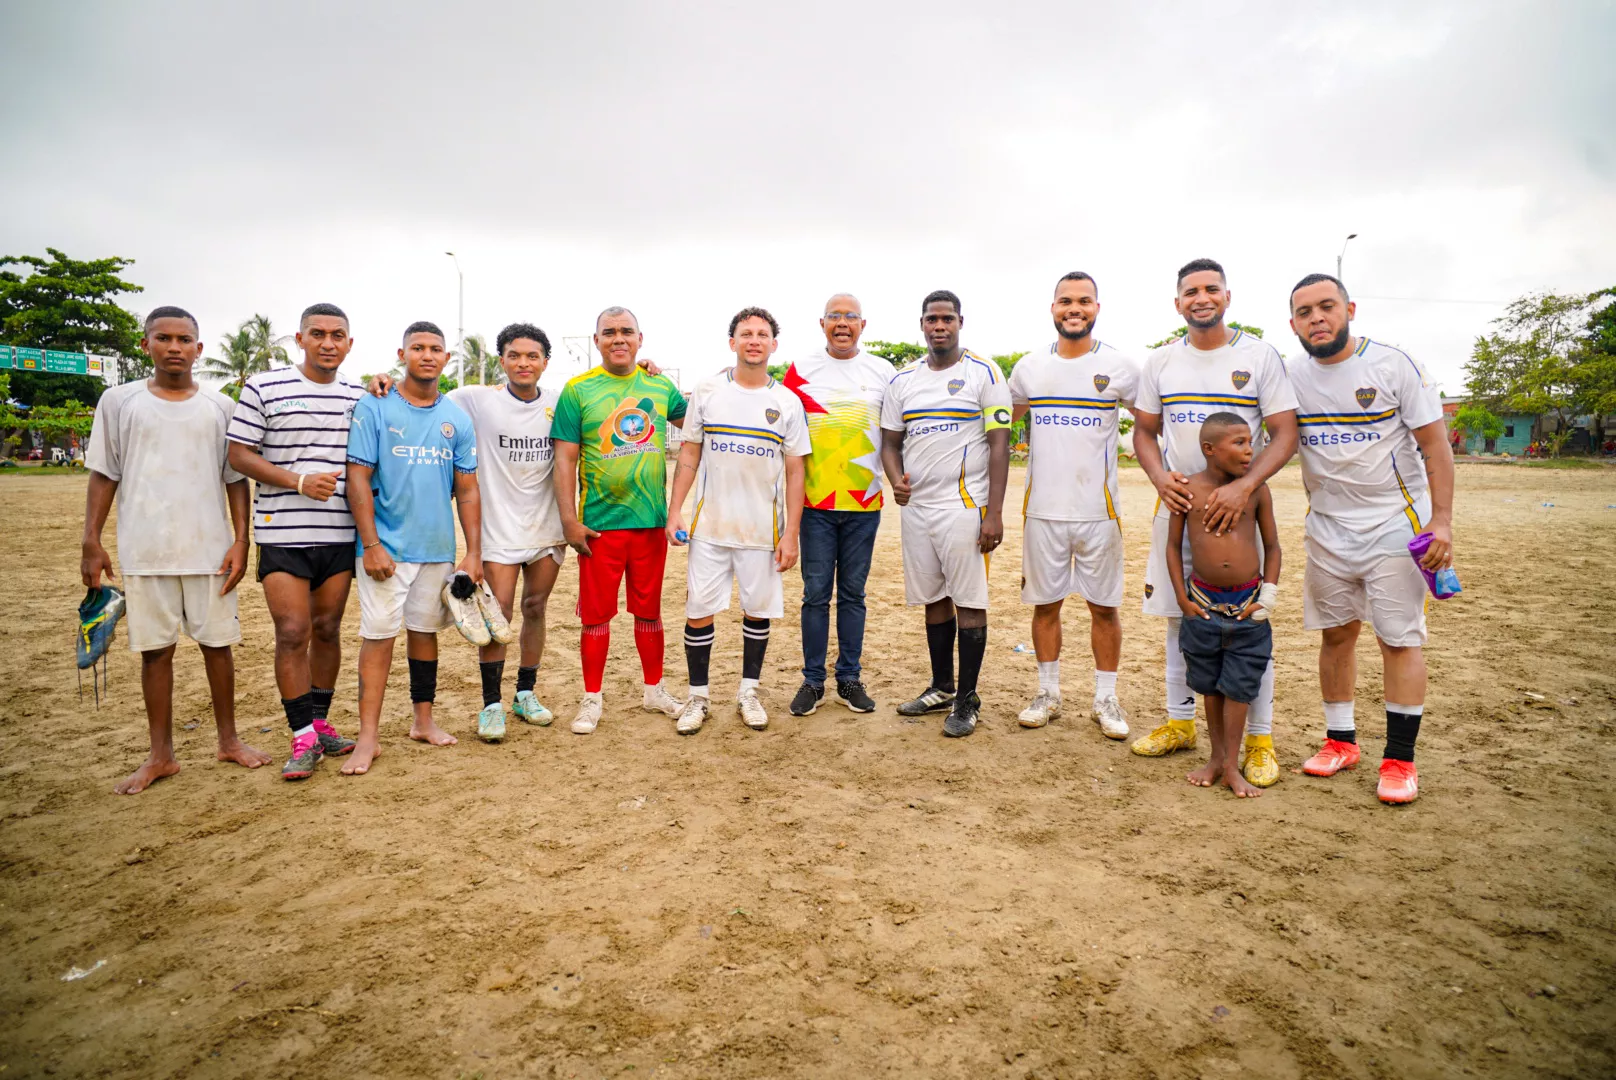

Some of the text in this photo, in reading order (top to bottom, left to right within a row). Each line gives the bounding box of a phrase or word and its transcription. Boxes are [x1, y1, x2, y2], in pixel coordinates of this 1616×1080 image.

[1357, 393, 1376, 401] CABJ
[994, 409, 1010, 424] C
[1035, 413, 1101, 427] betsson
[908, 423, 959, 437] etsson
[498, 435, 553, 448] Emirate
[509, 449, 551, 462] FLY BETTER
[711, 440, 774, 458] betsson
